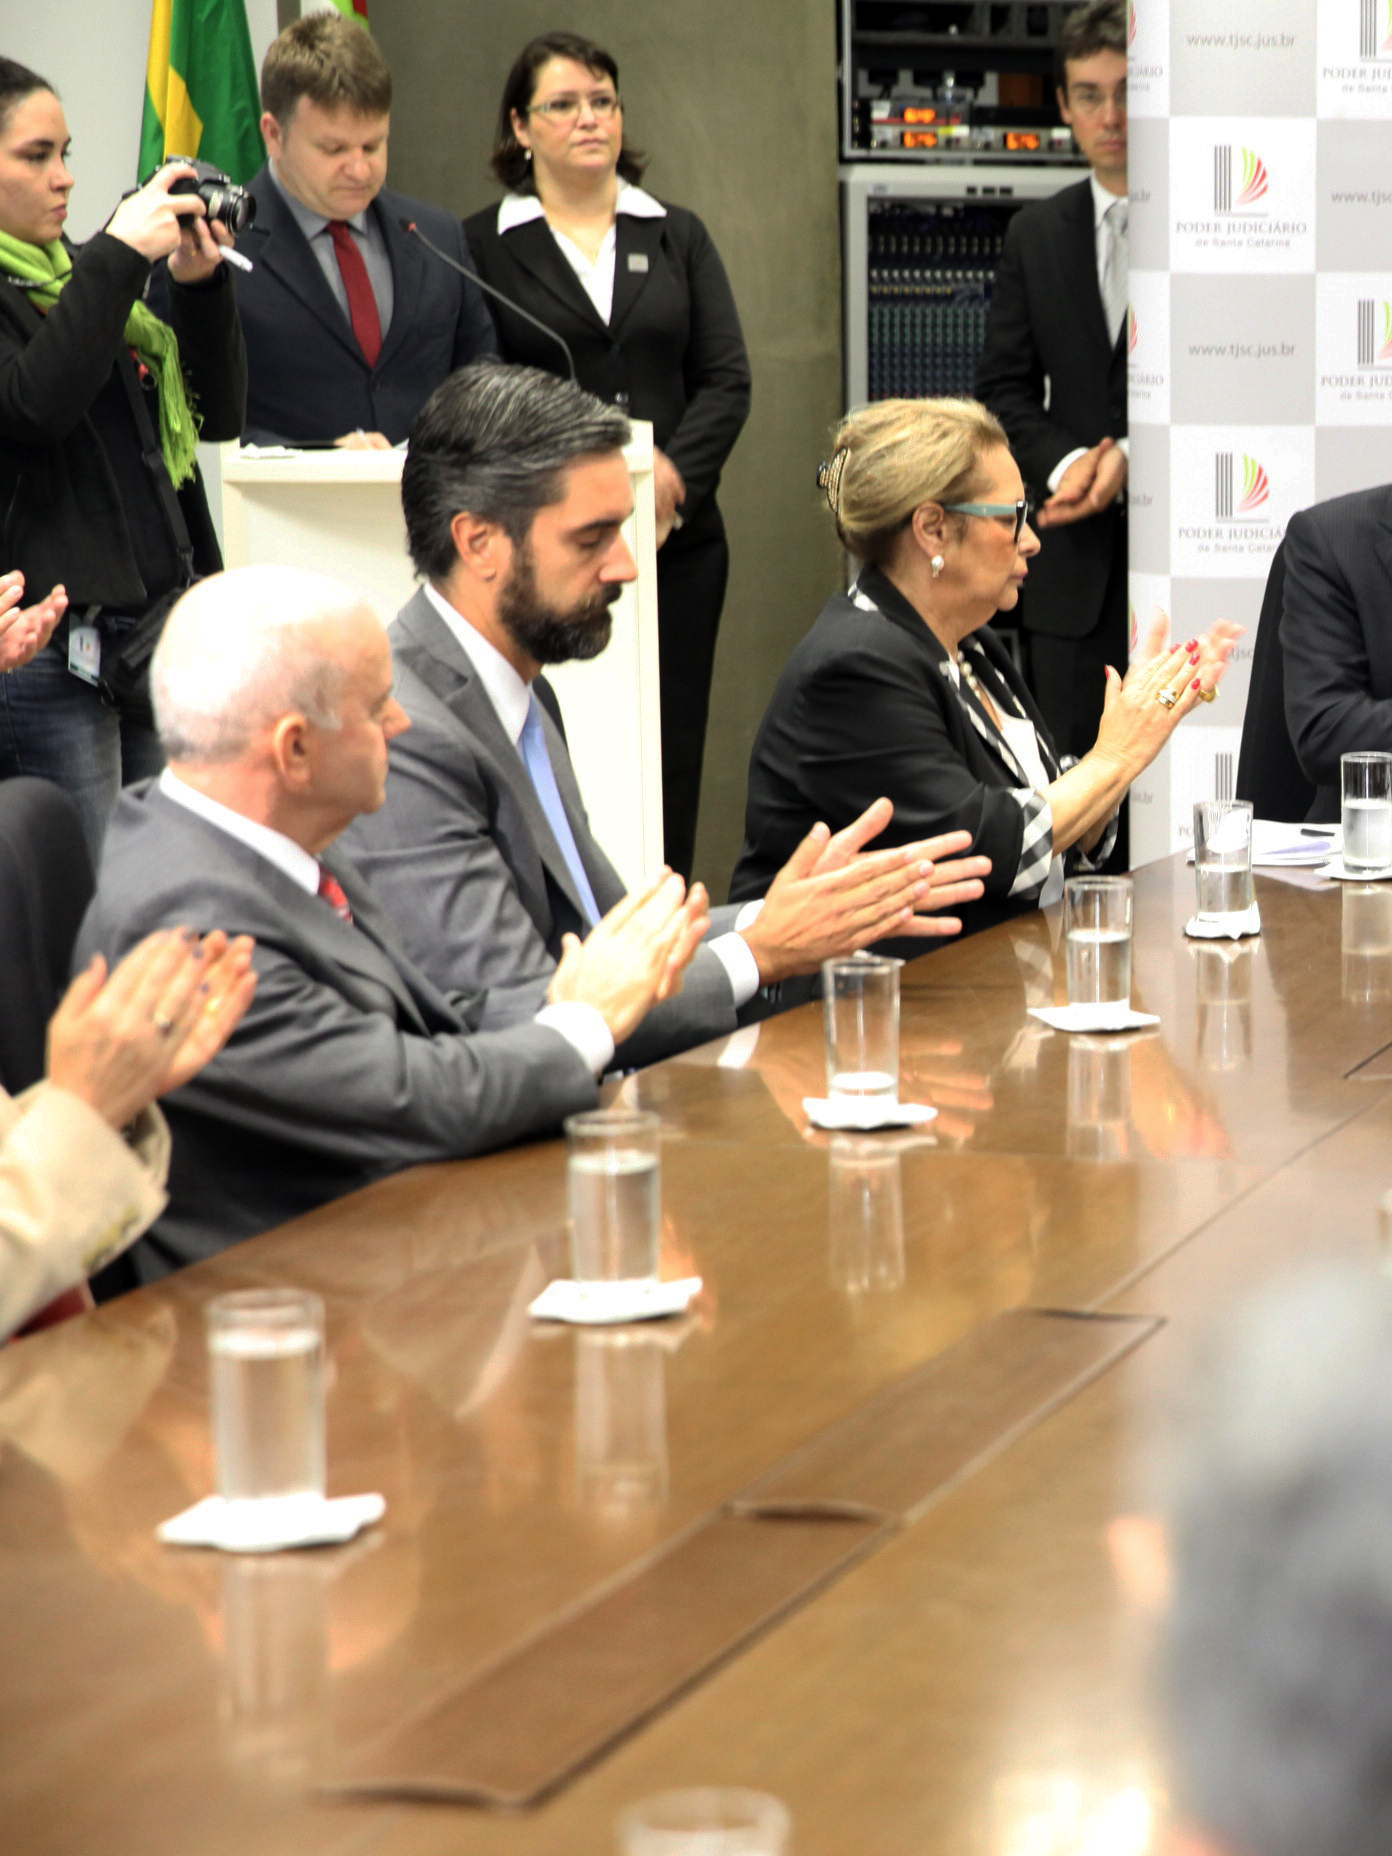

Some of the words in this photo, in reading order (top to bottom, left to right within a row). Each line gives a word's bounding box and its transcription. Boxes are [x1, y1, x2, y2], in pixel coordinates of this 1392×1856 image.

[1186, 34, 1296, 49] www.tjsc.jus.br
[1323, 67, 1368, 78] PODER
[1176, 222, 1221, 233] PODER
[1226, 221, 1307, 234] JUDICIÁRIO
[1188, 341, 1296, 359] www.tjsc.jus.br
[1321, 376, 1366, 388] PODER
[1179, 528, 1225, 540] PODER
[1229, 525, 1284, 542] JUDICIÁ
